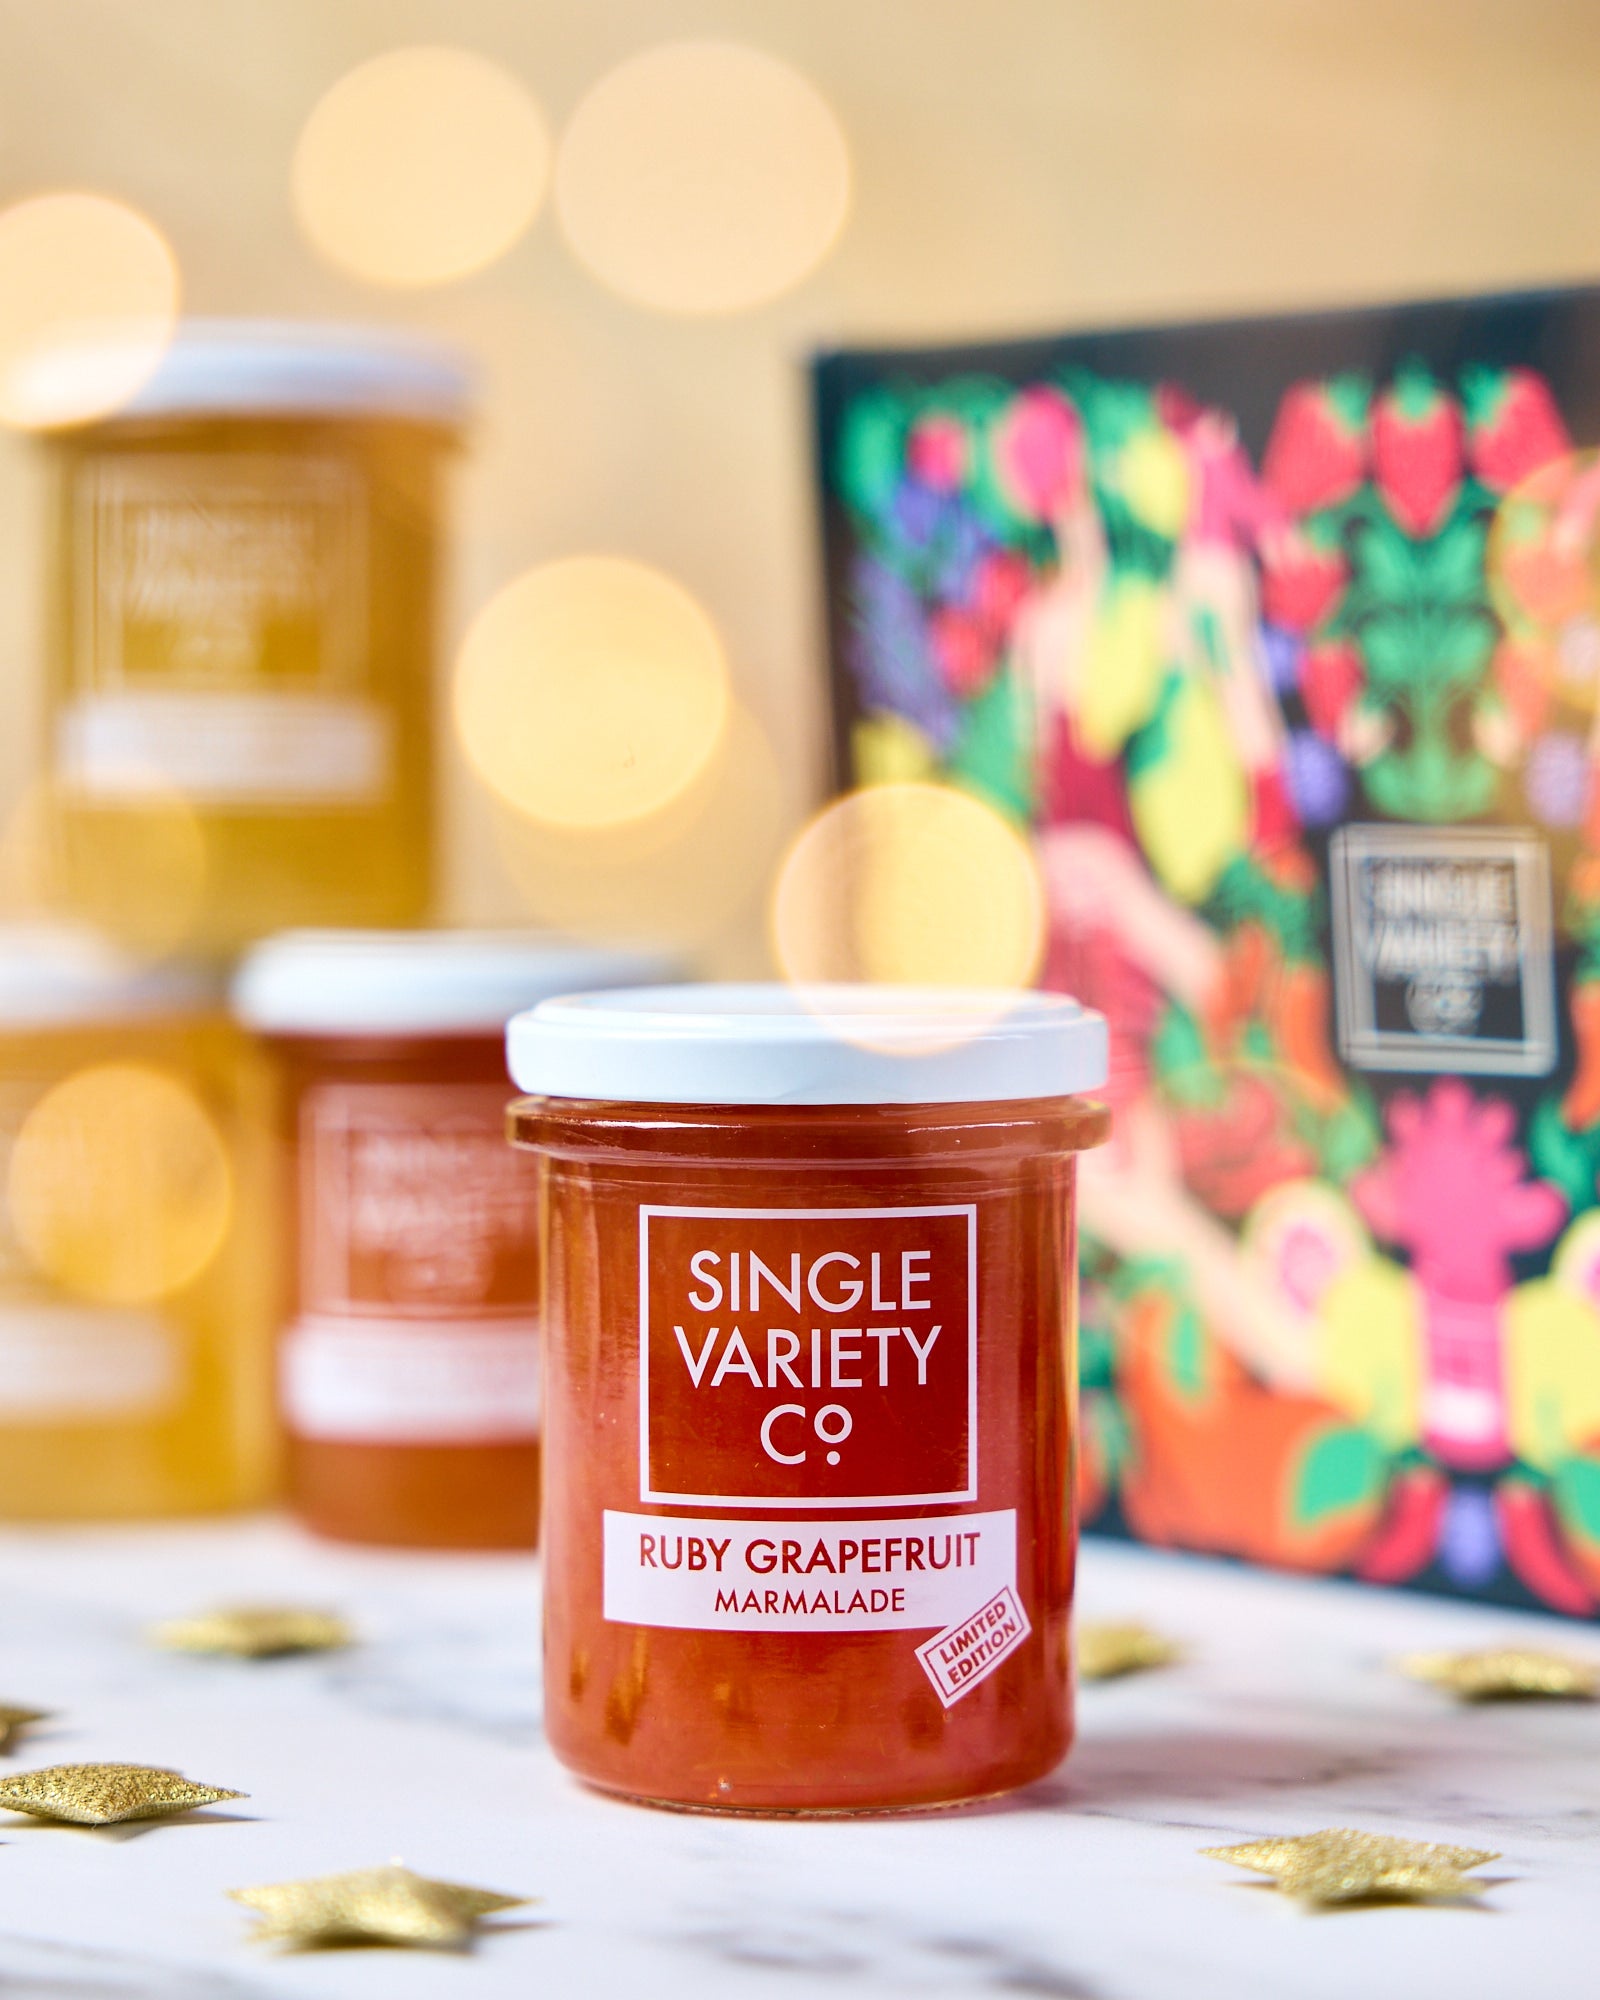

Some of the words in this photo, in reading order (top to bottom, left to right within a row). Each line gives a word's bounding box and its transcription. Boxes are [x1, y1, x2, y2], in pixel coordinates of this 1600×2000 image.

[688, 1250, 931, 1313] SINGLE
[673, 1326, 942, 1388] VARIETY
[639, 1533, 731, 1571] RUBY
[744, 1532, 981, 1574] GRAPEFRUIT
[714, 1588, 905, 1614] MARMALADE
[939, 1600, 1007, 1664] LIMITED
[947, 1619, 1016, 1685] EDITION
